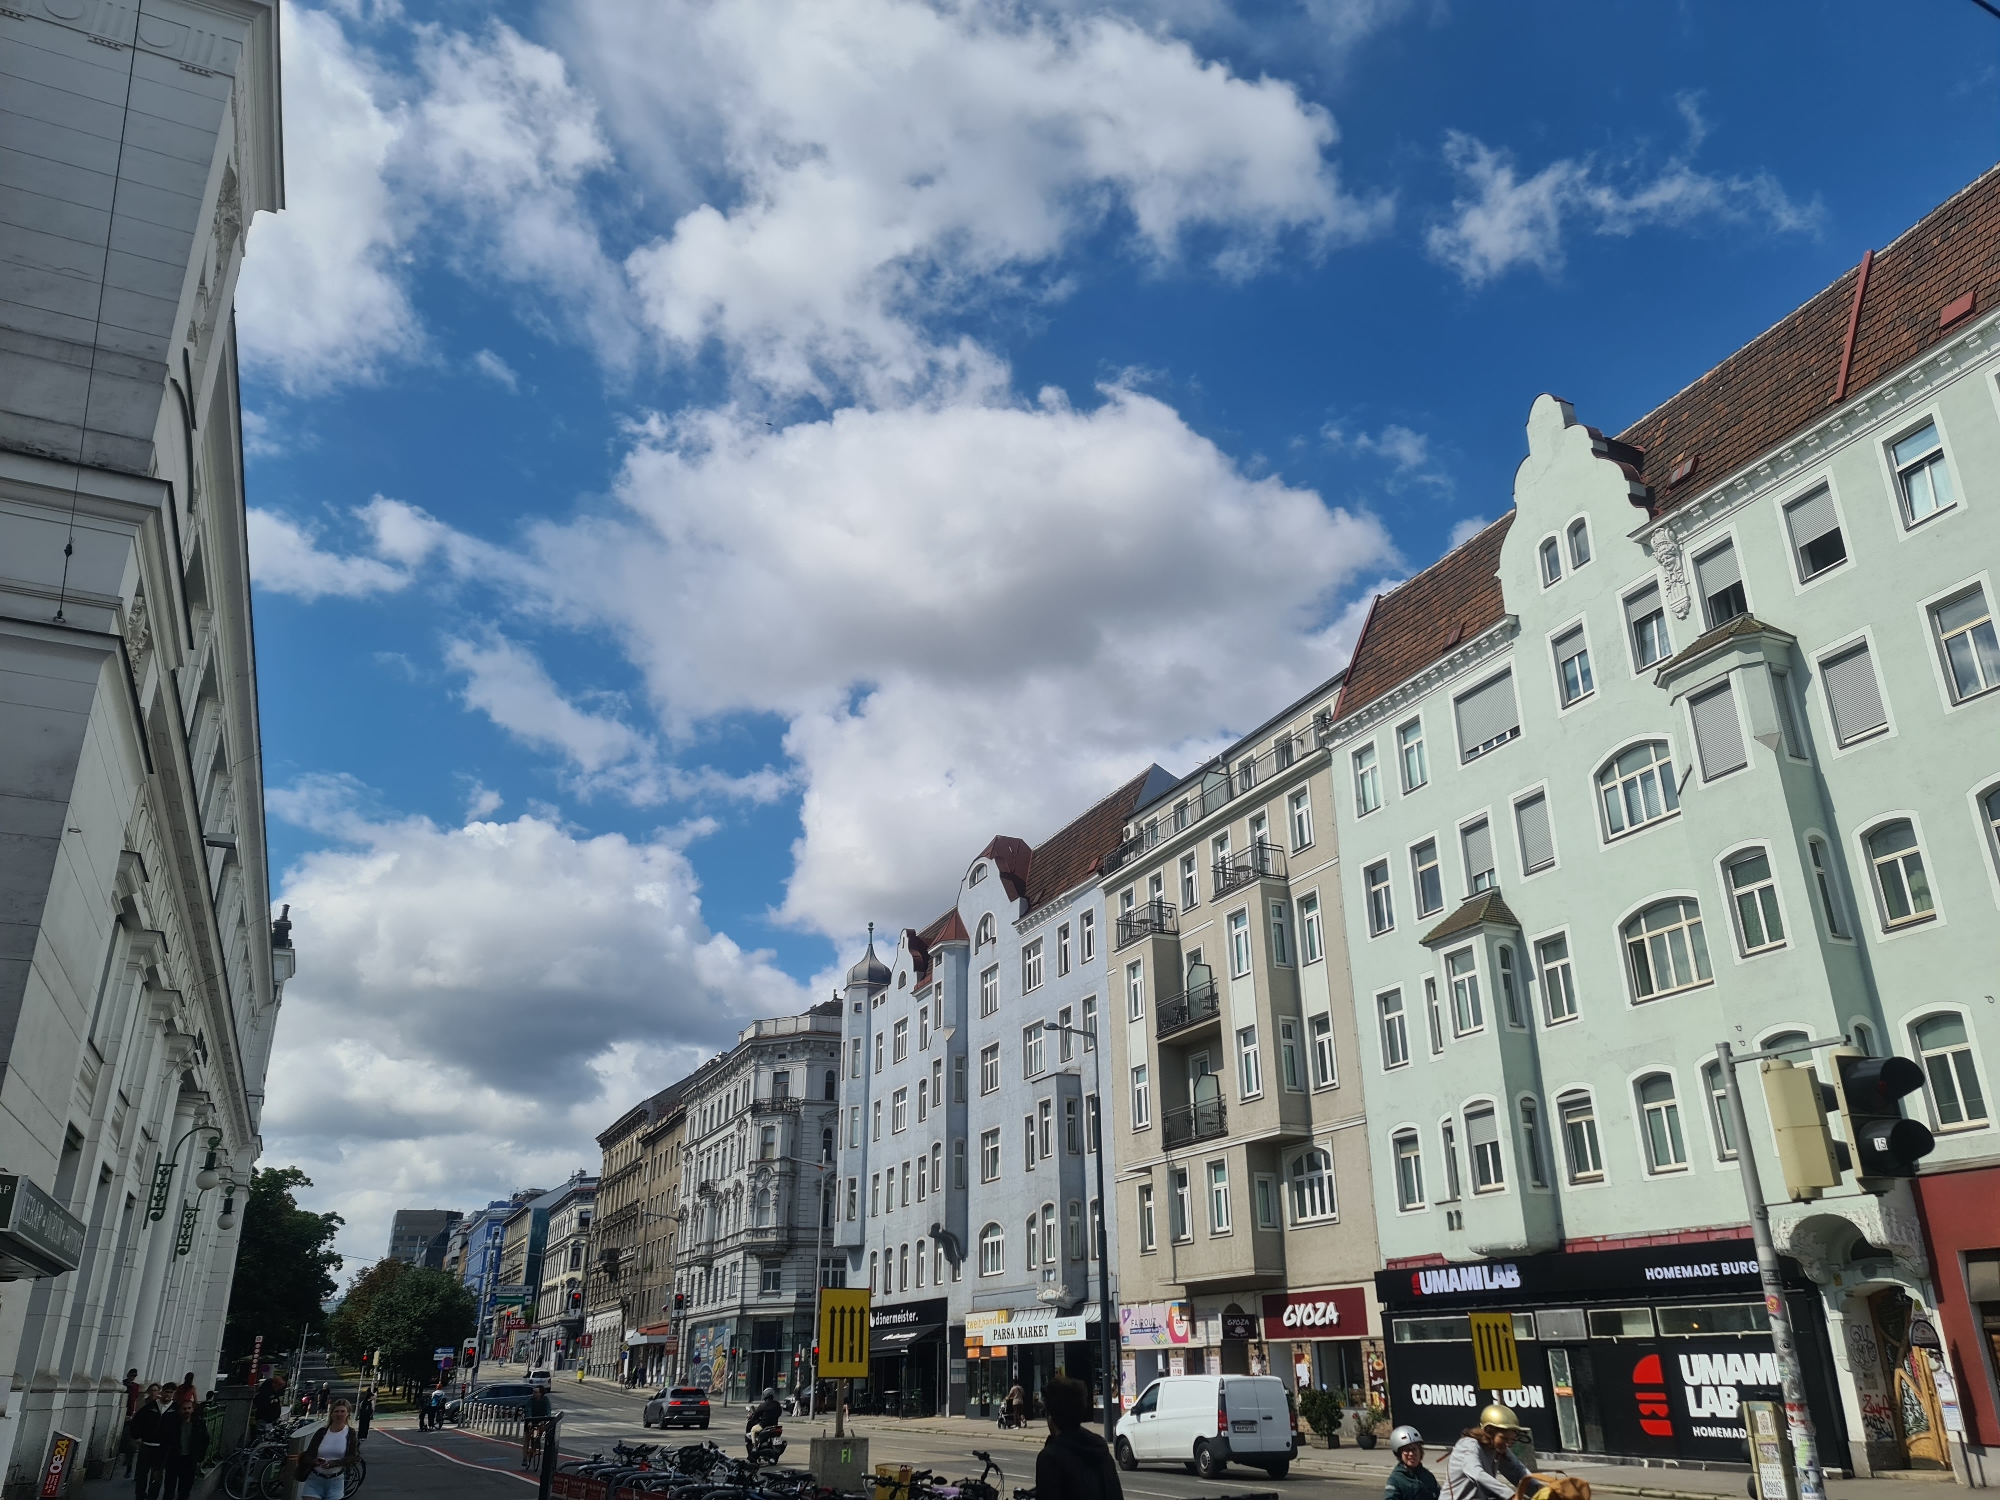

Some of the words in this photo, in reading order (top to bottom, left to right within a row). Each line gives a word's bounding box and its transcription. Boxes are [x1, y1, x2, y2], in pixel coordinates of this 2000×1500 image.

[1876, 1139, 1887, 1150] 15
[1418, 1263, 1521, 1295] UMAMILAB
[1645, 1263, 1719, 1280] HOMEMADE
[1721, 1261, 1759, 1275] BURG
[1226, 1318, 1250, 1326] GYOZA
[1283, 1301, 1339, 1327] GYOZA
[993, 1328, 1016, 1341] PARSA
[1017, 1324, 1049, 1338] MARKET
[1411, 1383, 1477, 1407] COMING
[1684, 1386, 1741, 1418] LAB
[1692, 1426, 1747, 1439] HOMEMAD
